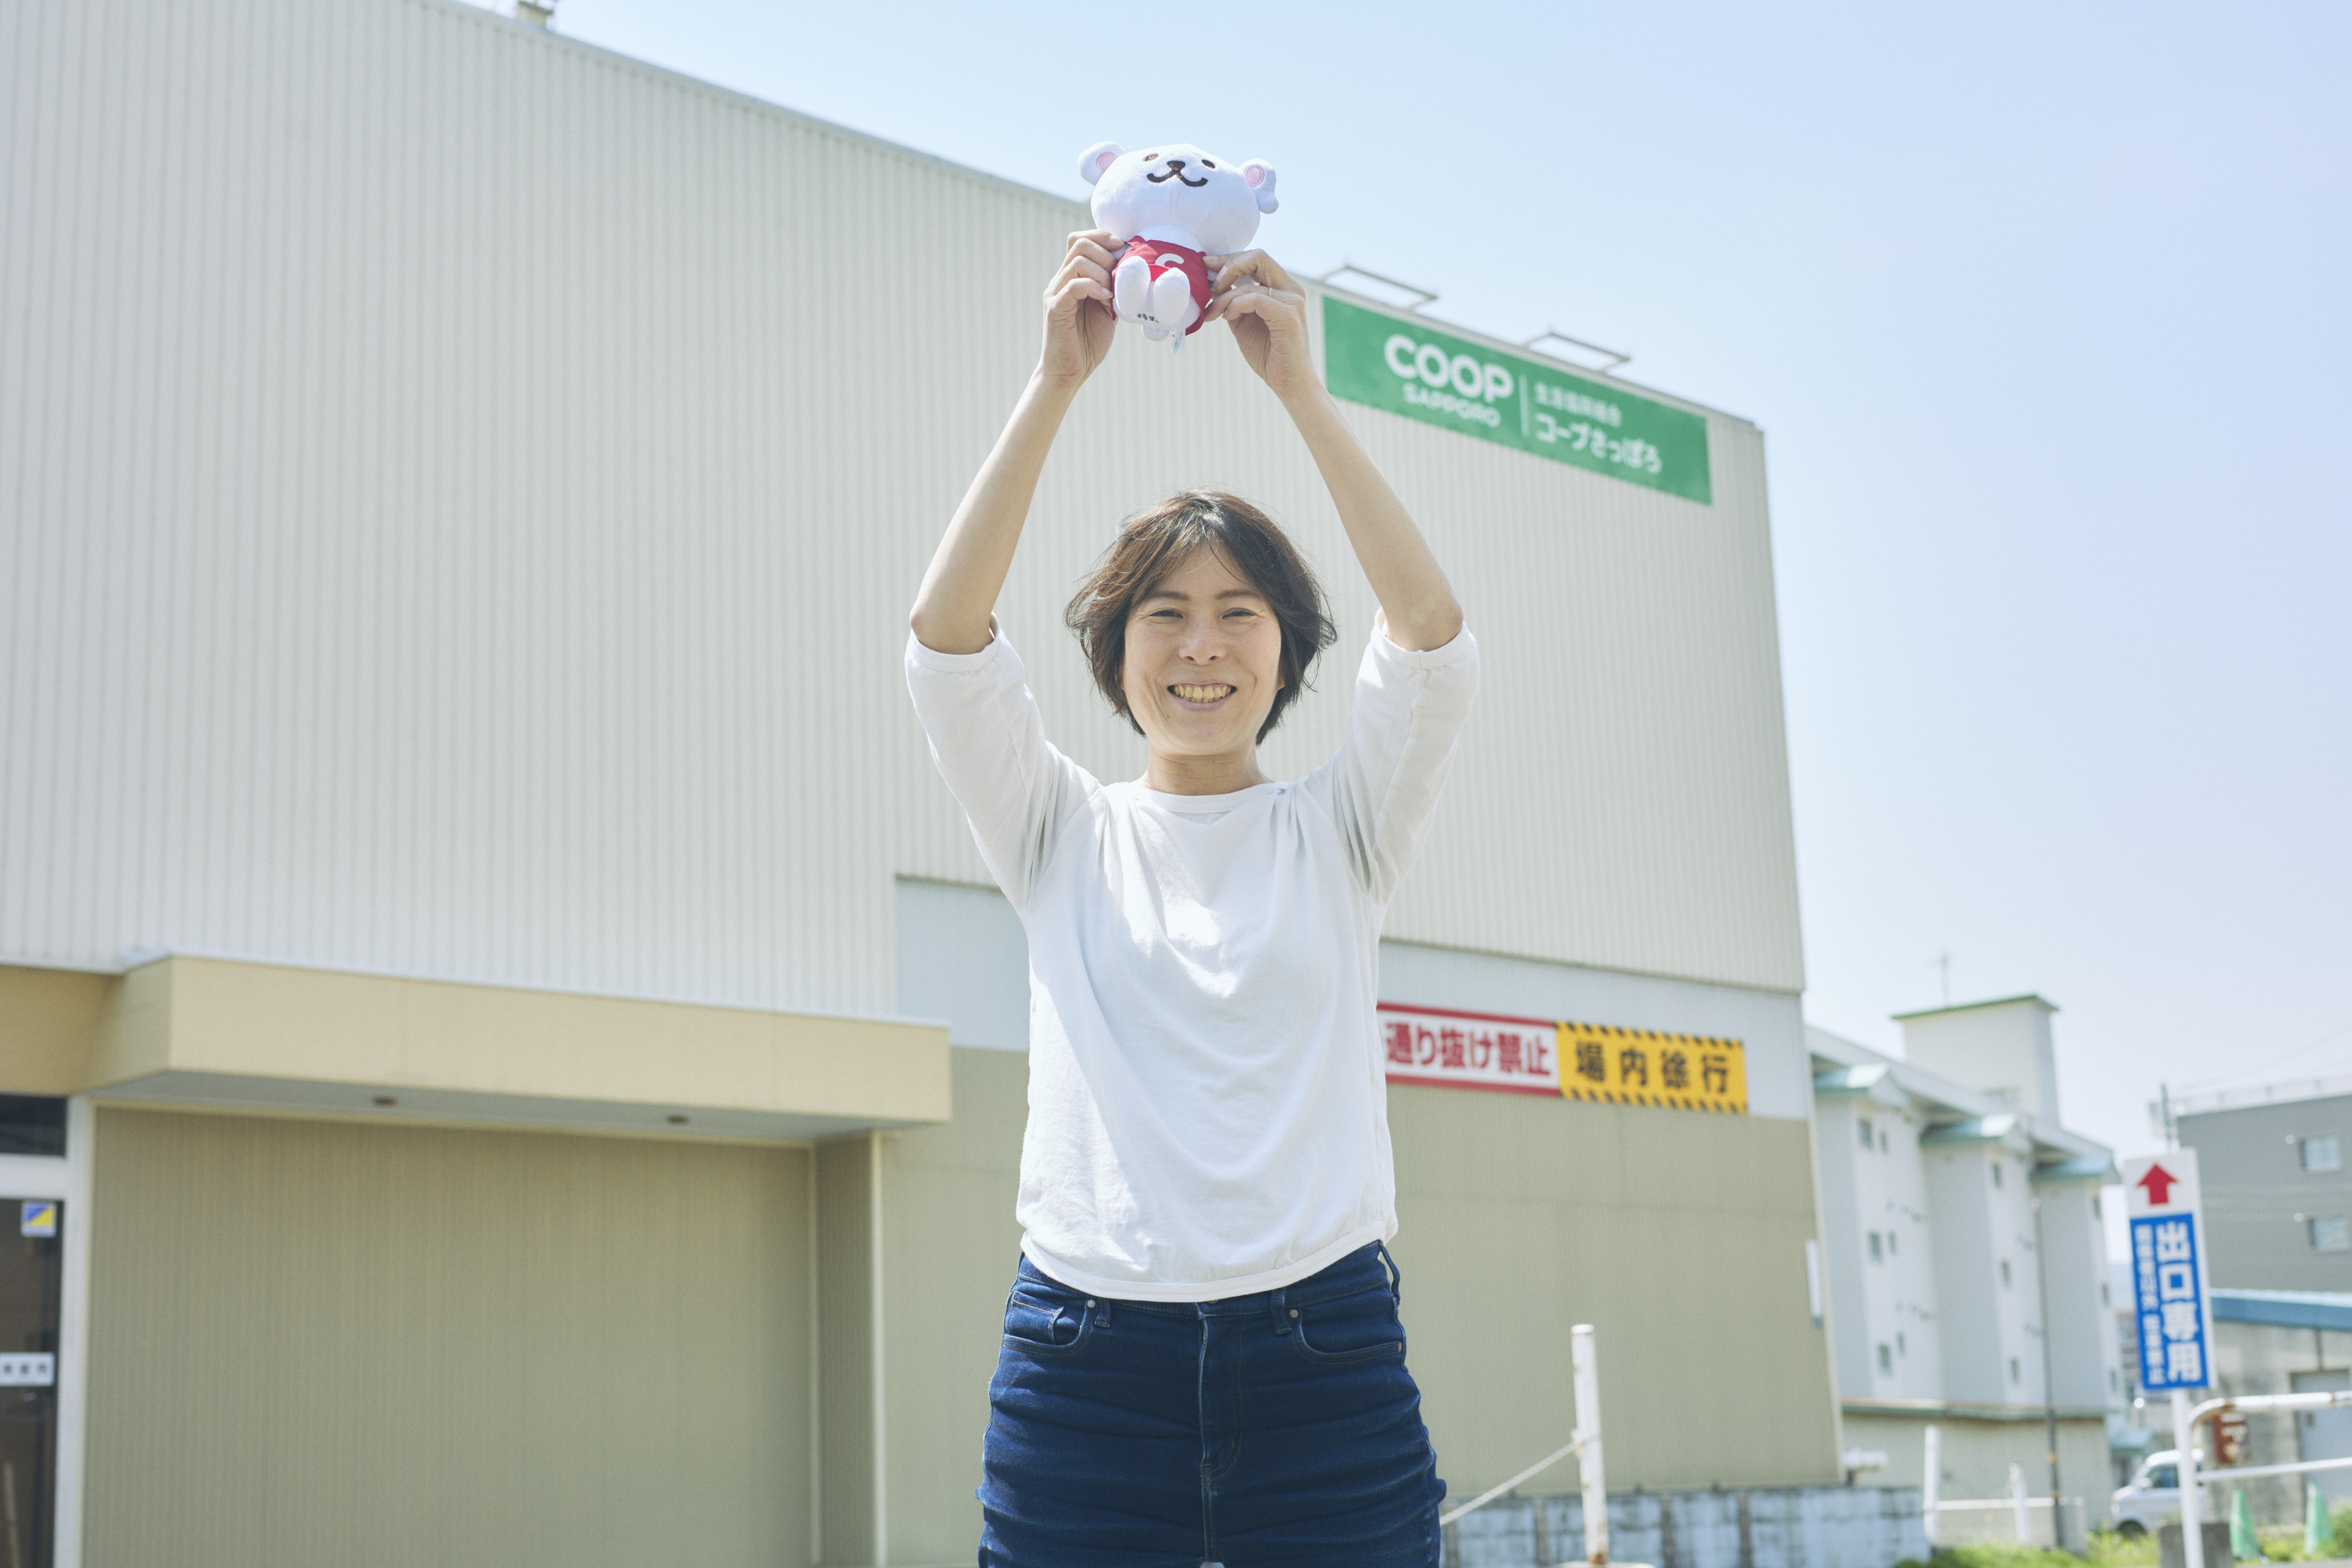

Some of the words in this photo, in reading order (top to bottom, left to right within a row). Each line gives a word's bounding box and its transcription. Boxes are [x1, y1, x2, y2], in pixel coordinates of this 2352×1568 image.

[1384, 334, 1514, 403] COOP
[1403, 382, 1501, 428] SAPPORO
[1534, 412, 1662, 474] コープさっぽろ
[1385, 1021, 1551, 1077] 通り抜け禁止
[1576, 1039, 1729, 1095] 場内徐行
[2155, 1221, 2203, 1383] 出口専用
